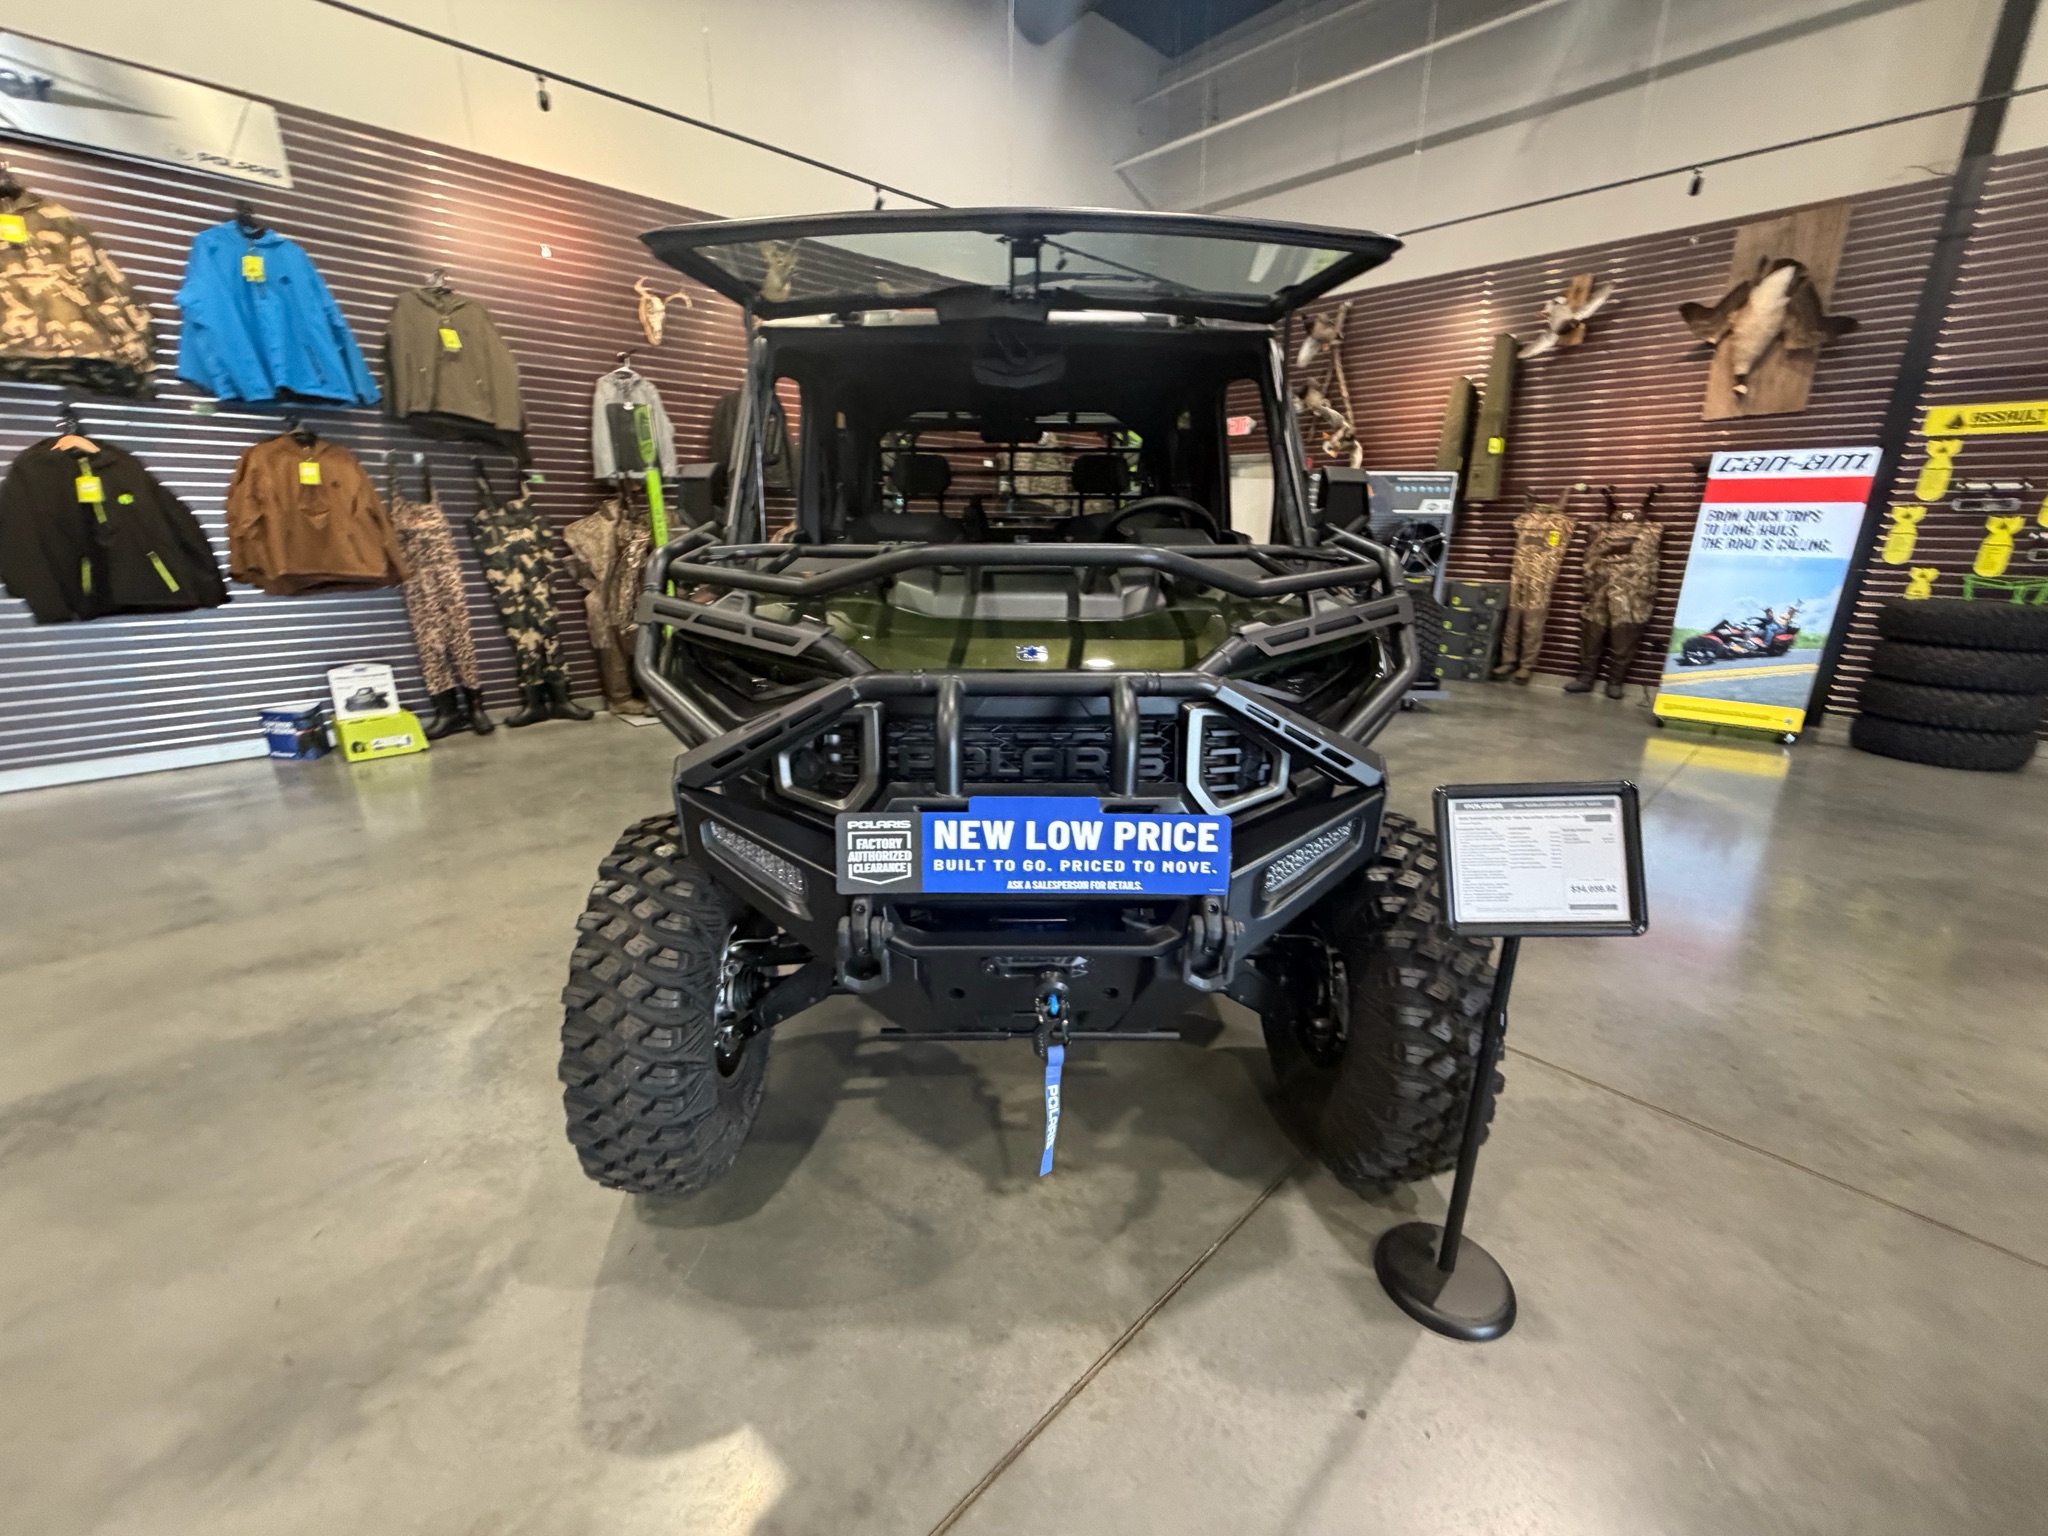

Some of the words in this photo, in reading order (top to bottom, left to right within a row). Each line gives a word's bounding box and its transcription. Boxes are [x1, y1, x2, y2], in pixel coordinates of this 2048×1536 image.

[903, 745, 1165, 777] POLARS
[847, 820, 912, 829] POLARIS
[934, 820, 1015, 850] NEW
[1026, 820, 1103, 851] LOW
[1113, 821, 1220, 853] PRICE
[856, 838, 904, 850] FACTORY
[847, 850, 912, 863] AUTHORIZED
[853, 862, 908, 874] CLEARANCE
[933, 859, 986, 871] BUILT
[993, 859, 1016, 872] TO
[1022, 859, 1053, 872] GO.
[1060, 860, 1126, 873] PRICED
[1132, 860, 1155, 873] TO
[1162, 860, 1218, 875] MOVE.
[1006, 880, 1024, 890] ASK
[1024, 880, 1032, 890] A
[1032, 880, 1089, 890] SALESPERSON
[1090, 880, 1107, 890] FOR
[1107, 880, 1143, 891] DETAILS.
[1045, 1084, 1059, 1150] POLARIS
